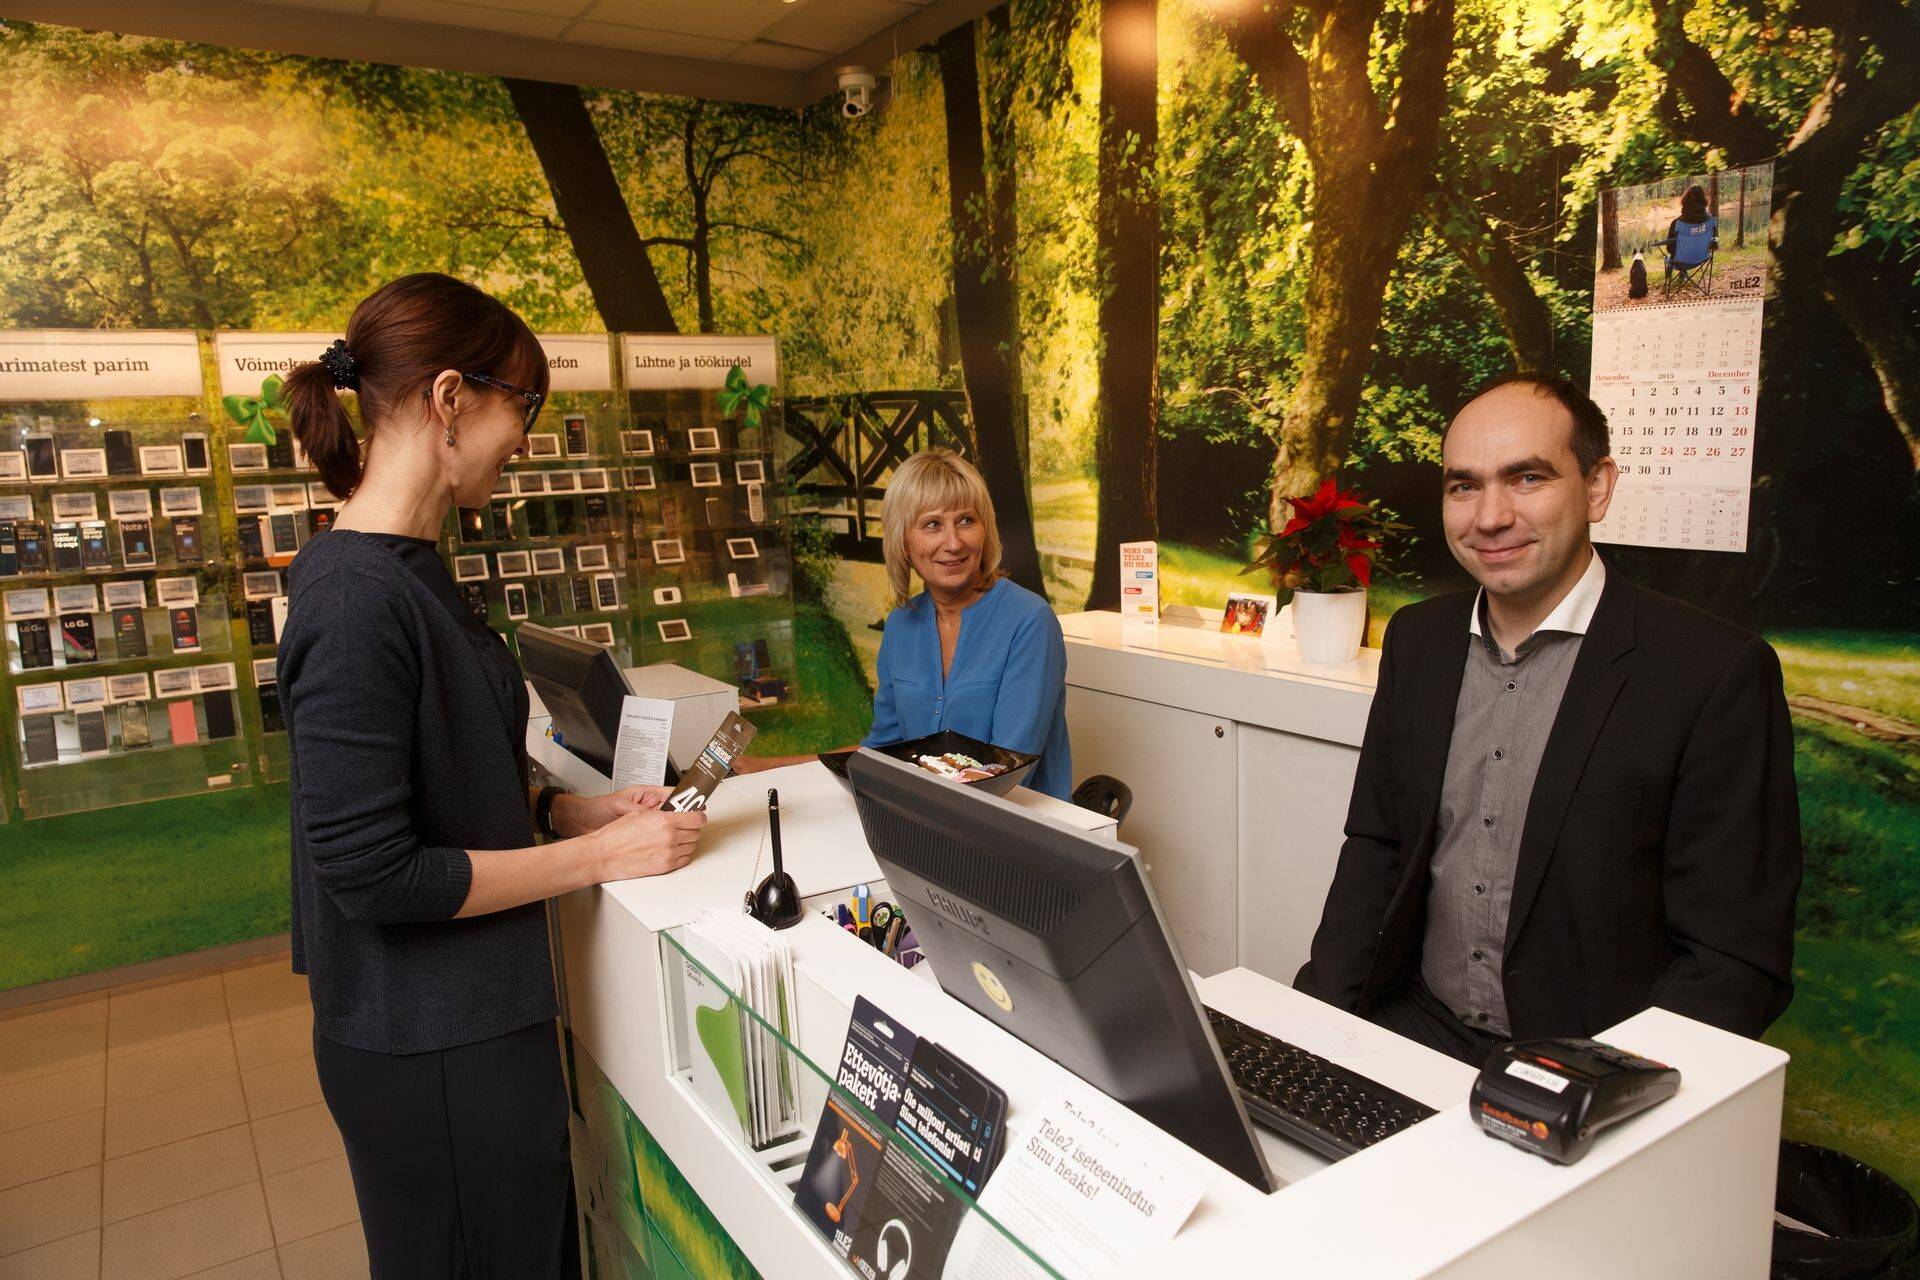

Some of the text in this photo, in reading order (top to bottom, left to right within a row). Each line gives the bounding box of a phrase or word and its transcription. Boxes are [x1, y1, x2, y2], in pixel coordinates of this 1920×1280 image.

[1730, 276, 1760, 290] TELE2
[93, 358, 149, 375] parim
[549, 356, 578, 368] efon
[636, 356, 751, 371] Lihtne ja töökindel
[1631, 386, 1750, 396] 1 2 3 4 5 6
[1610, 406, 1749, 416] 7 8 9 10 11 12 13
[1622, 427, 1633, 436] 15
[1642, 427, 1654, 436] 16
[1663, 427, 1676, 436] 17
[1686, 427, 1698, 436] 18
[1709, 427, 1722, 436] 19
[1732, 427, 1747, 436] 20
[1620, 446, 1631, 455] 22
[1640, 447, 1652, 455] 23
[1660, 447, 1674, 456] 24
[1683, 447, 1696, 456] 25
[1706, 447, 1720, 457] 26
[1730, 448, 1745, 457] 27
[1619, 465, 1671, 475] 29 30 31
[844, 1042, 901, 1102] Ettevõtja-
[838, 1066, 878, 1110] pakett
[904, 1087, 917, 1109] Üle
[917, 1102, 945, 1134] miljoni
[900, 1104, 918, 1128] Sinu
[917, 1120, 955, 1162] telefonis!
[1027, 1136, 1055, 1166] Sinu
[1055, 1158, 1100, 1200] heaks!
[1039, 1118, 1156, 1217] Tele2 iseteenindus
